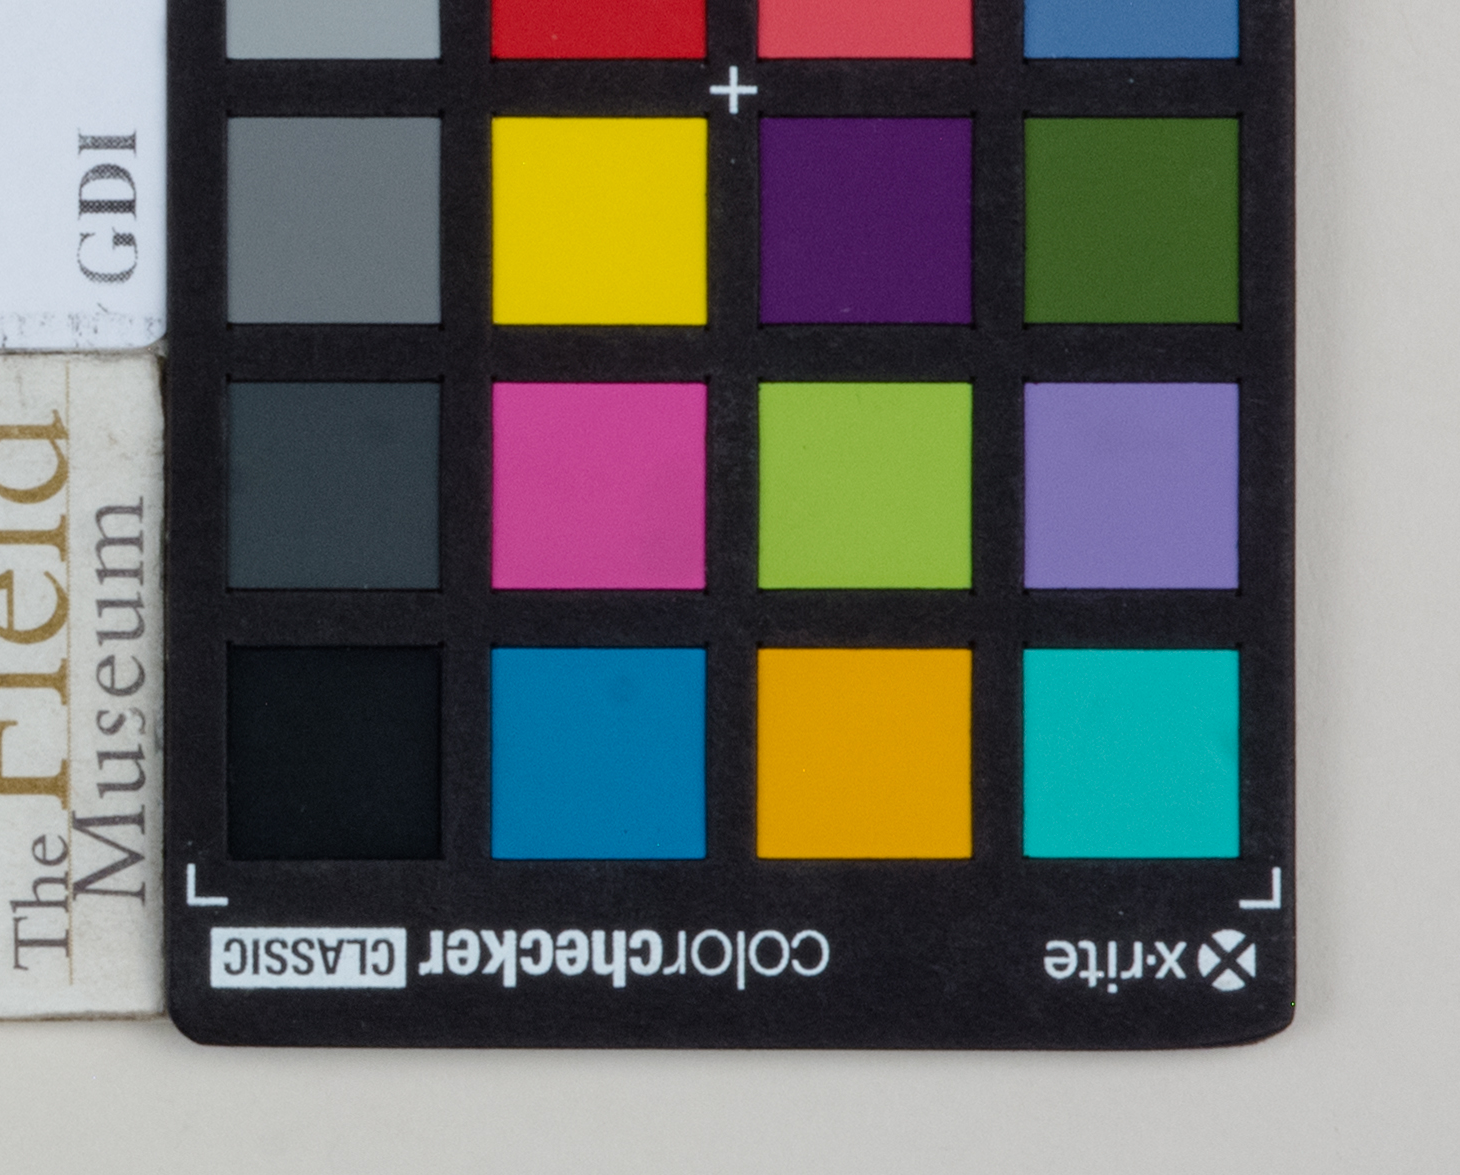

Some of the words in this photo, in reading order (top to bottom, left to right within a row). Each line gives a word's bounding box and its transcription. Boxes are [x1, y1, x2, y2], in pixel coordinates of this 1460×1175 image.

[77, 129, 138, 284] GDI
[72, 495, 146, 905] Museum
[10, 834, 70, 971] The
[223, 937, 396, 976] CLASSIC
[418, 928, 830, 991] colorchecker
